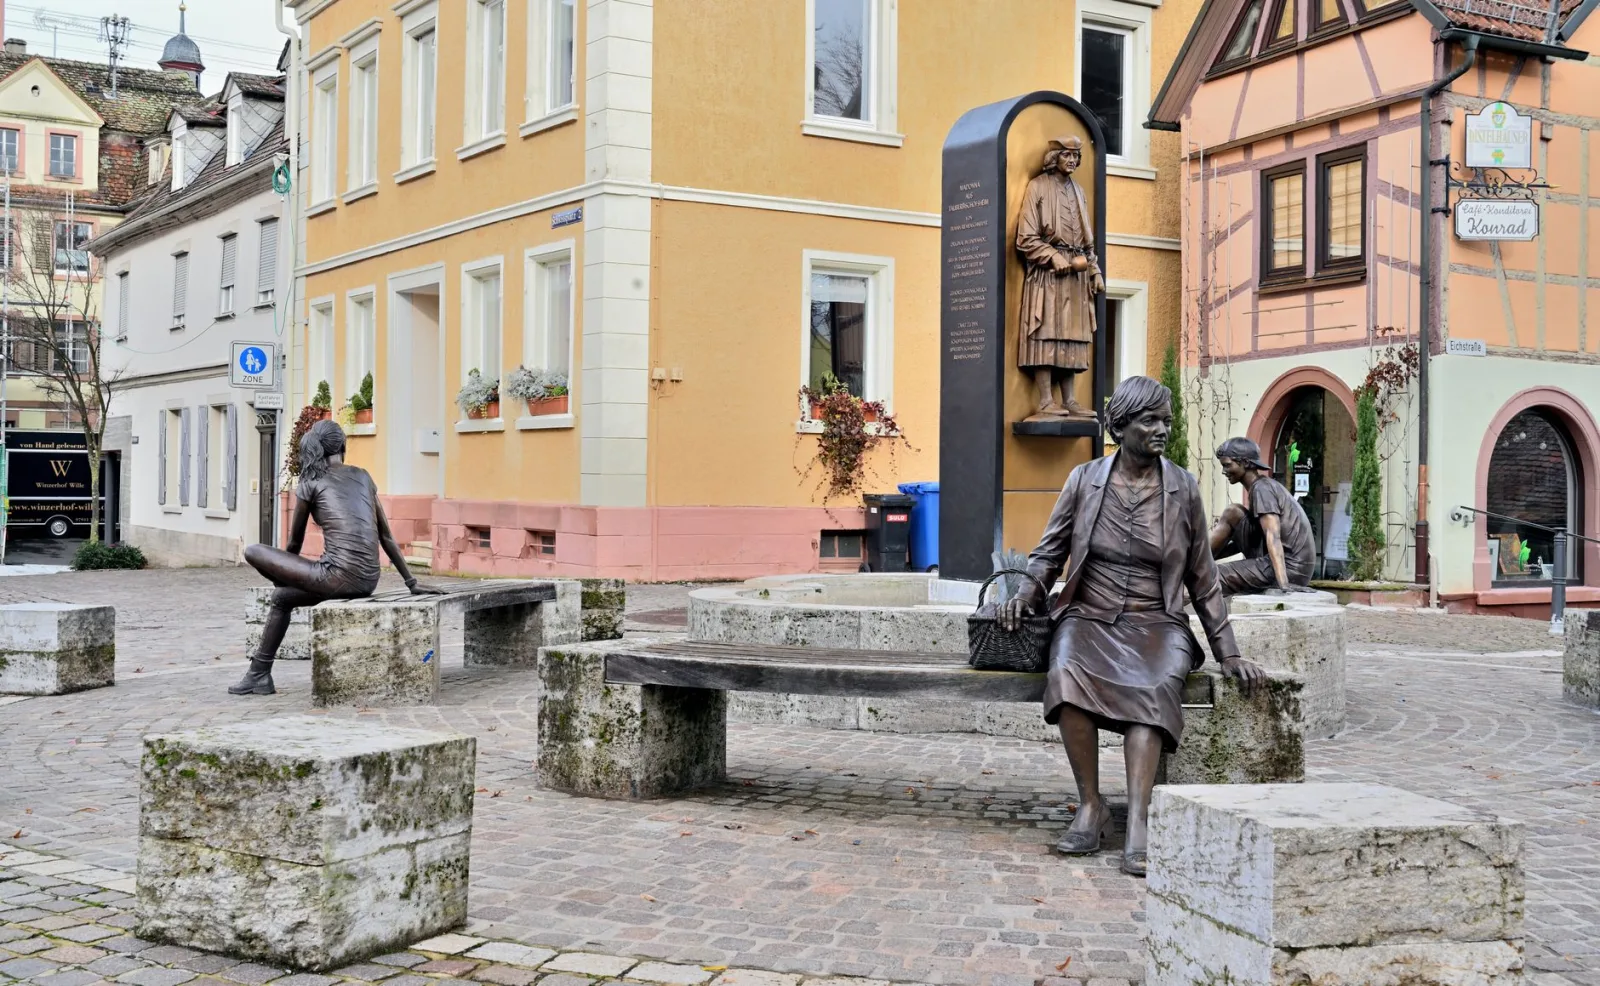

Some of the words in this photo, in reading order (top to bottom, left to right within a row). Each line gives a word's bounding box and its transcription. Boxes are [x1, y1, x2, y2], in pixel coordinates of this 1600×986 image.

[1467, 217, 1527, 235] Konrad
[1450, 341, 1481, 351] Eichstraße
[242, 375, 264, 383] ZONE
[49, 460, 73, 477] W
